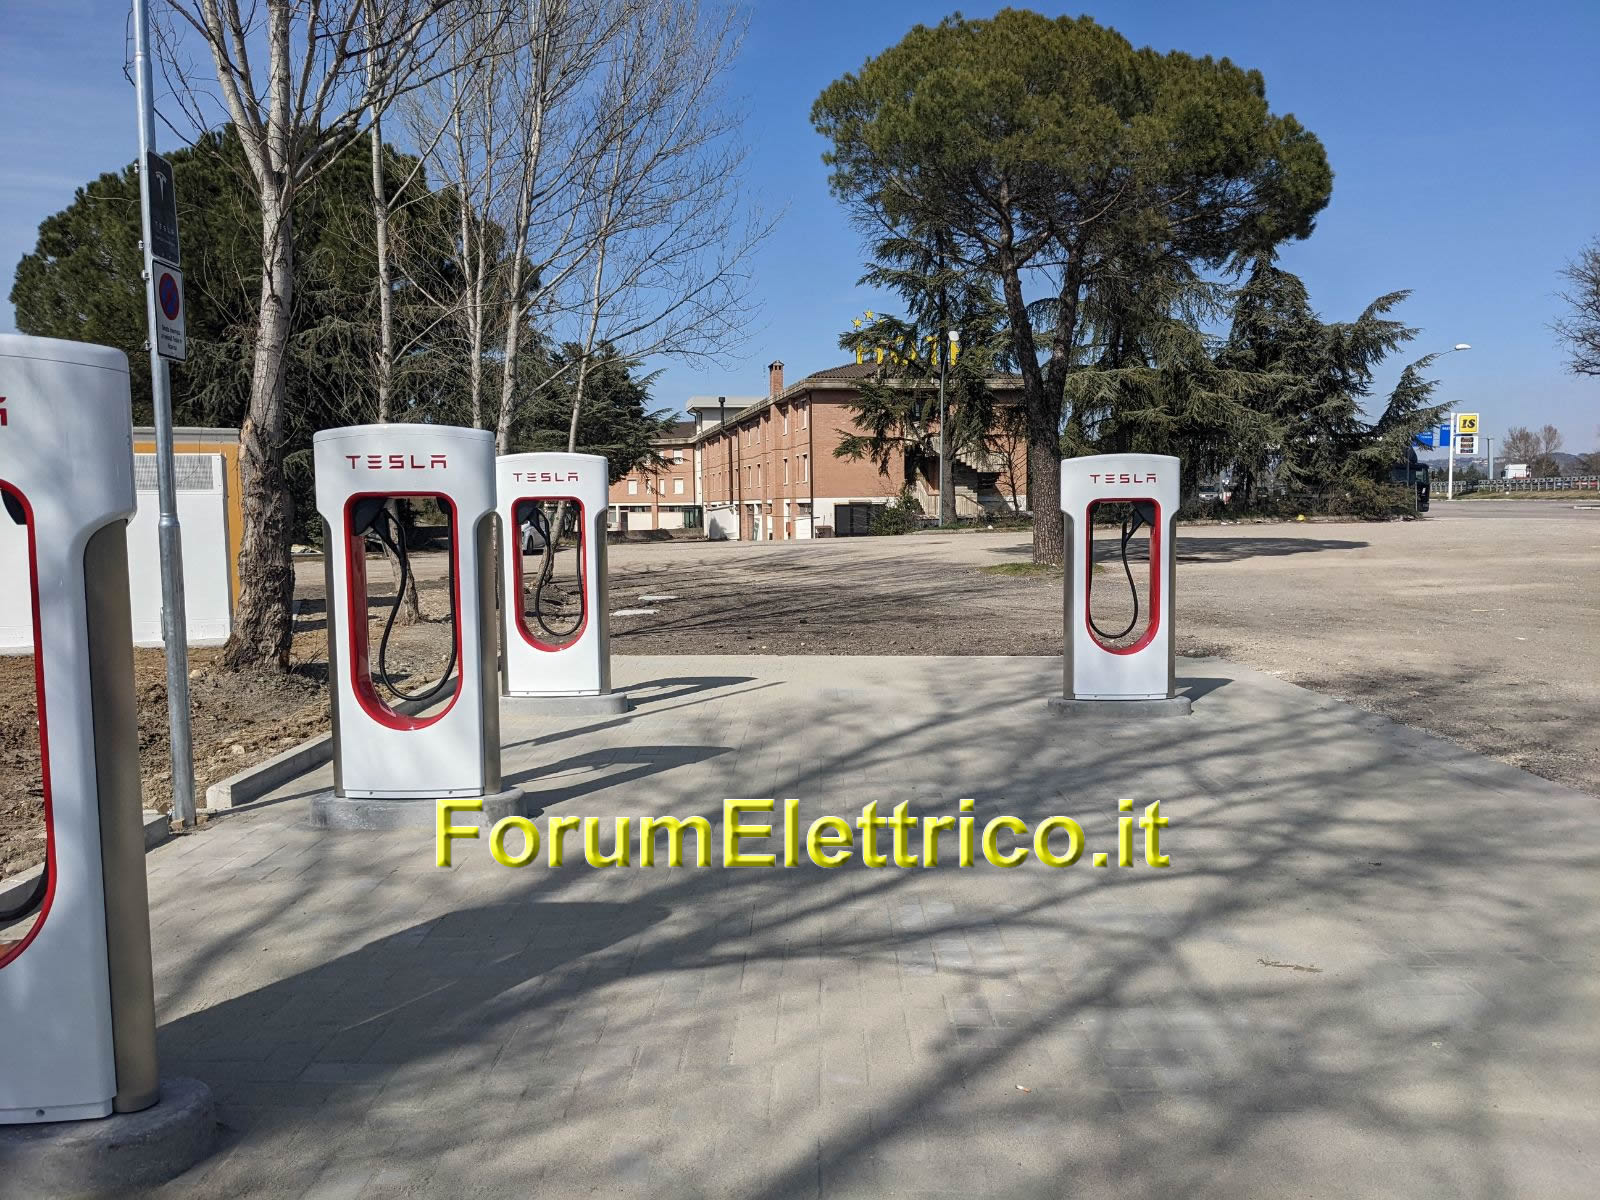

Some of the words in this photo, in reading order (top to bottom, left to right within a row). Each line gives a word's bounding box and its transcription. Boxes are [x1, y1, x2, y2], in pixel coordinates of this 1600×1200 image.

[345, 455, 447, 470] TESLA
[513, 472, 579, 483] TESLA
[1089, 473, 1157, 484] TESLA
